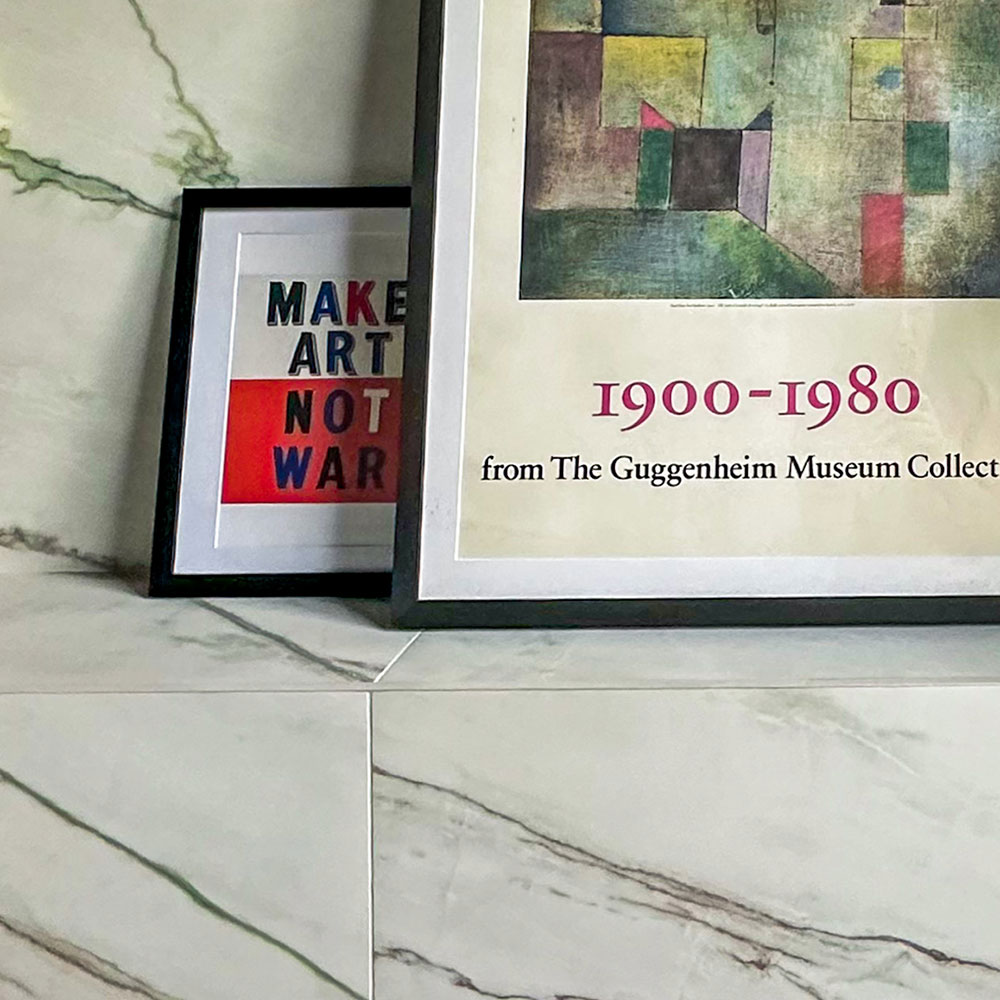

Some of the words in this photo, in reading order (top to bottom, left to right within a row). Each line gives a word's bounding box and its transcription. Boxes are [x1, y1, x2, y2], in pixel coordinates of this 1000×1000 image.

[267, 280, 408, 326] MAKE
[288, 331, 393, 376] ART
[284, 388, 390, 434] NOT
[591, 364, 921, 432] 1900-1980
[273, 446, 387, 490] WAR
[481, 455, 545, 481] from
[549, 454, 602, 480] The
[610, 453, 778, 487] Guggenheim
[785, 454, 901, 480] Museum
